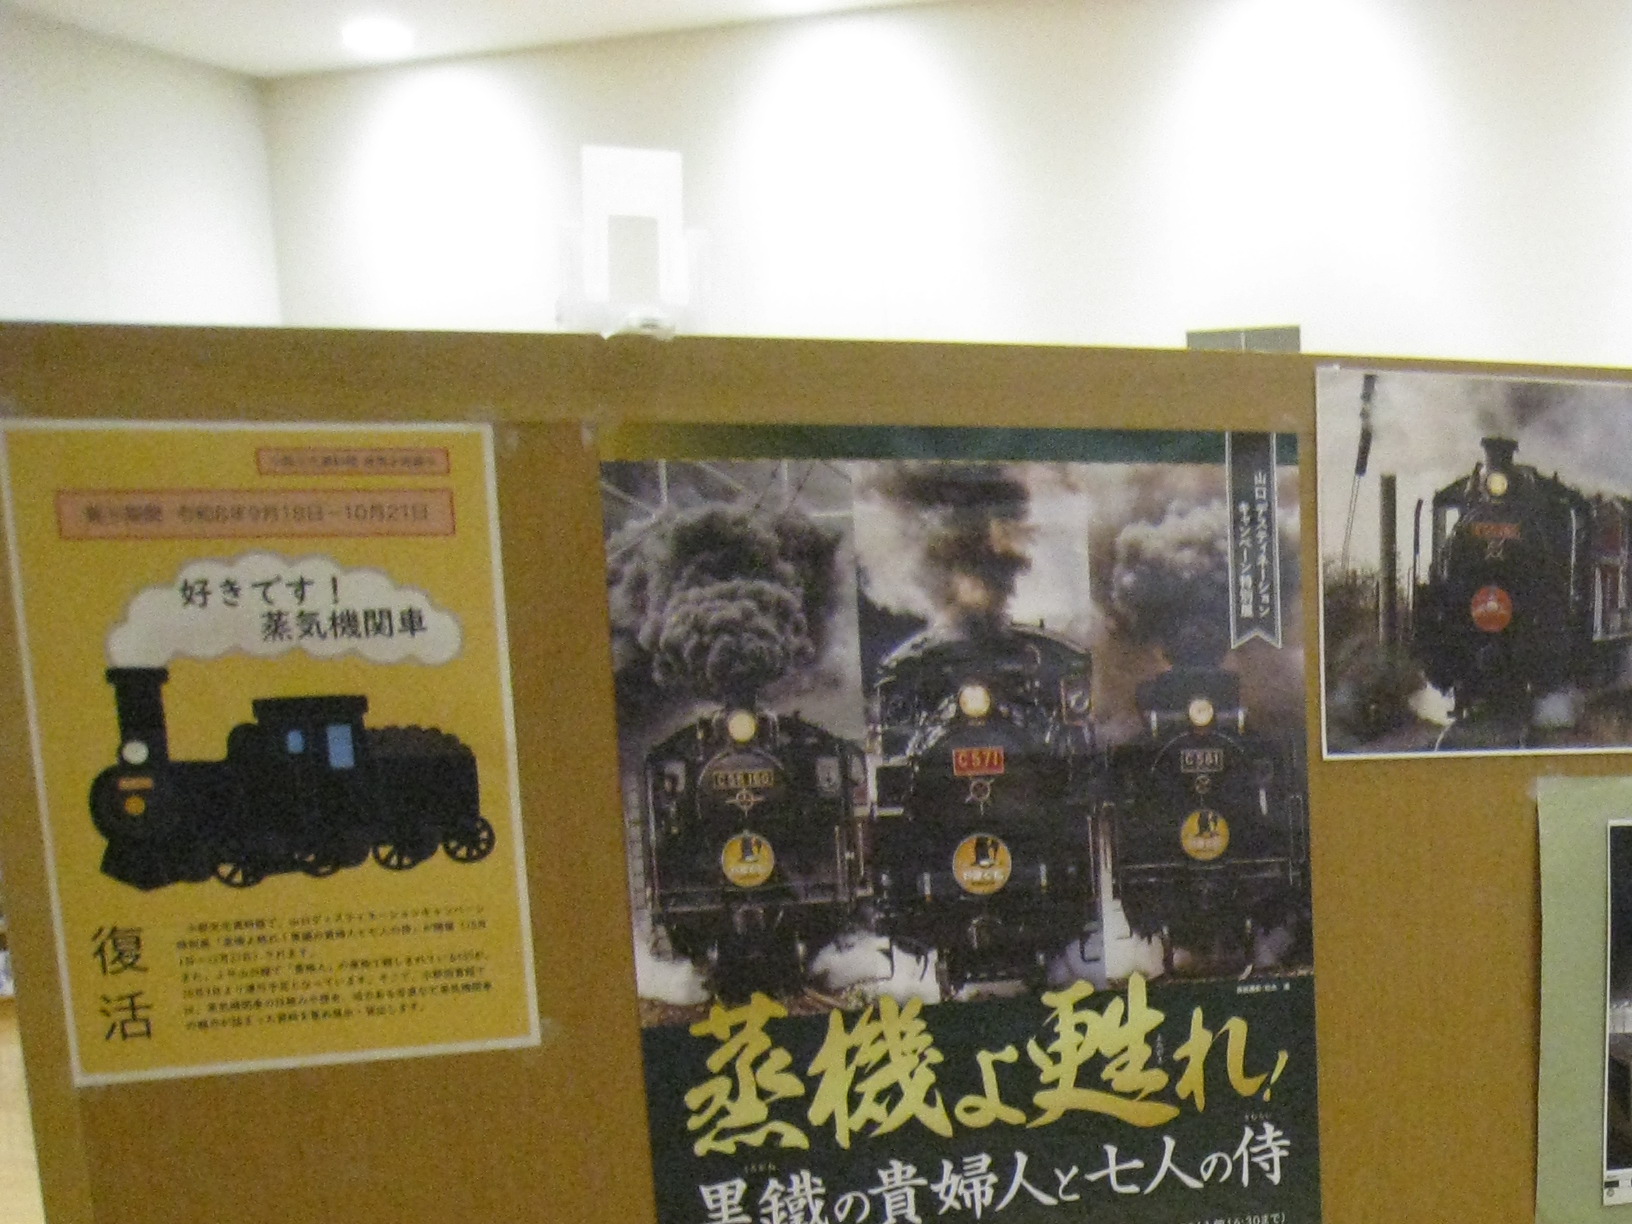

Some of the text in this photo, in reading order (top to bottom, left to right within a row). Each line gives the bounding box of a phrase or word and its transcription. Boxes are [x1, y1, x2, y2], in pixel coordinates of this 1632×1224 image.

[262, 608, 428, 641] 蒸気機関車
[91, 926, 152, 1041] 復活
